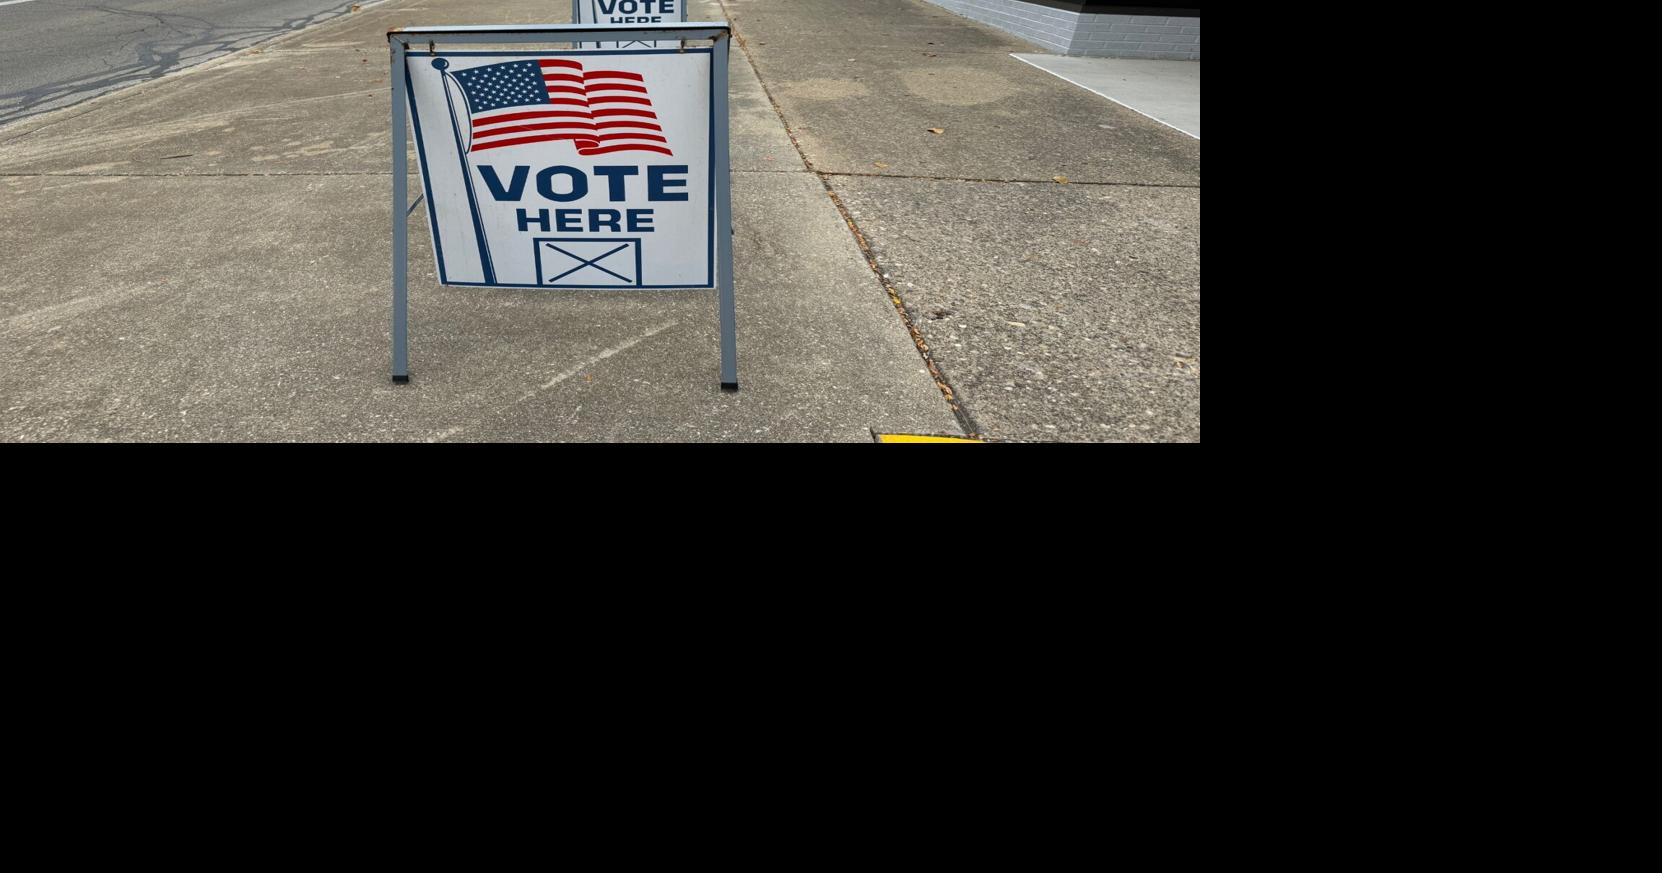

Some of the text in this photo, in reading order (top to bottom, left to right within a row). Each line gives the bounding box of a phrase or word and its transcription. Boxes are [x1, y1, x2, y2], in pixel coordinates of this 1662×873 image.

[597, 0, 675, 15] VOTE
[477, 164, 689, 202] VOTE
[516, 208, 655, 232] HERE
